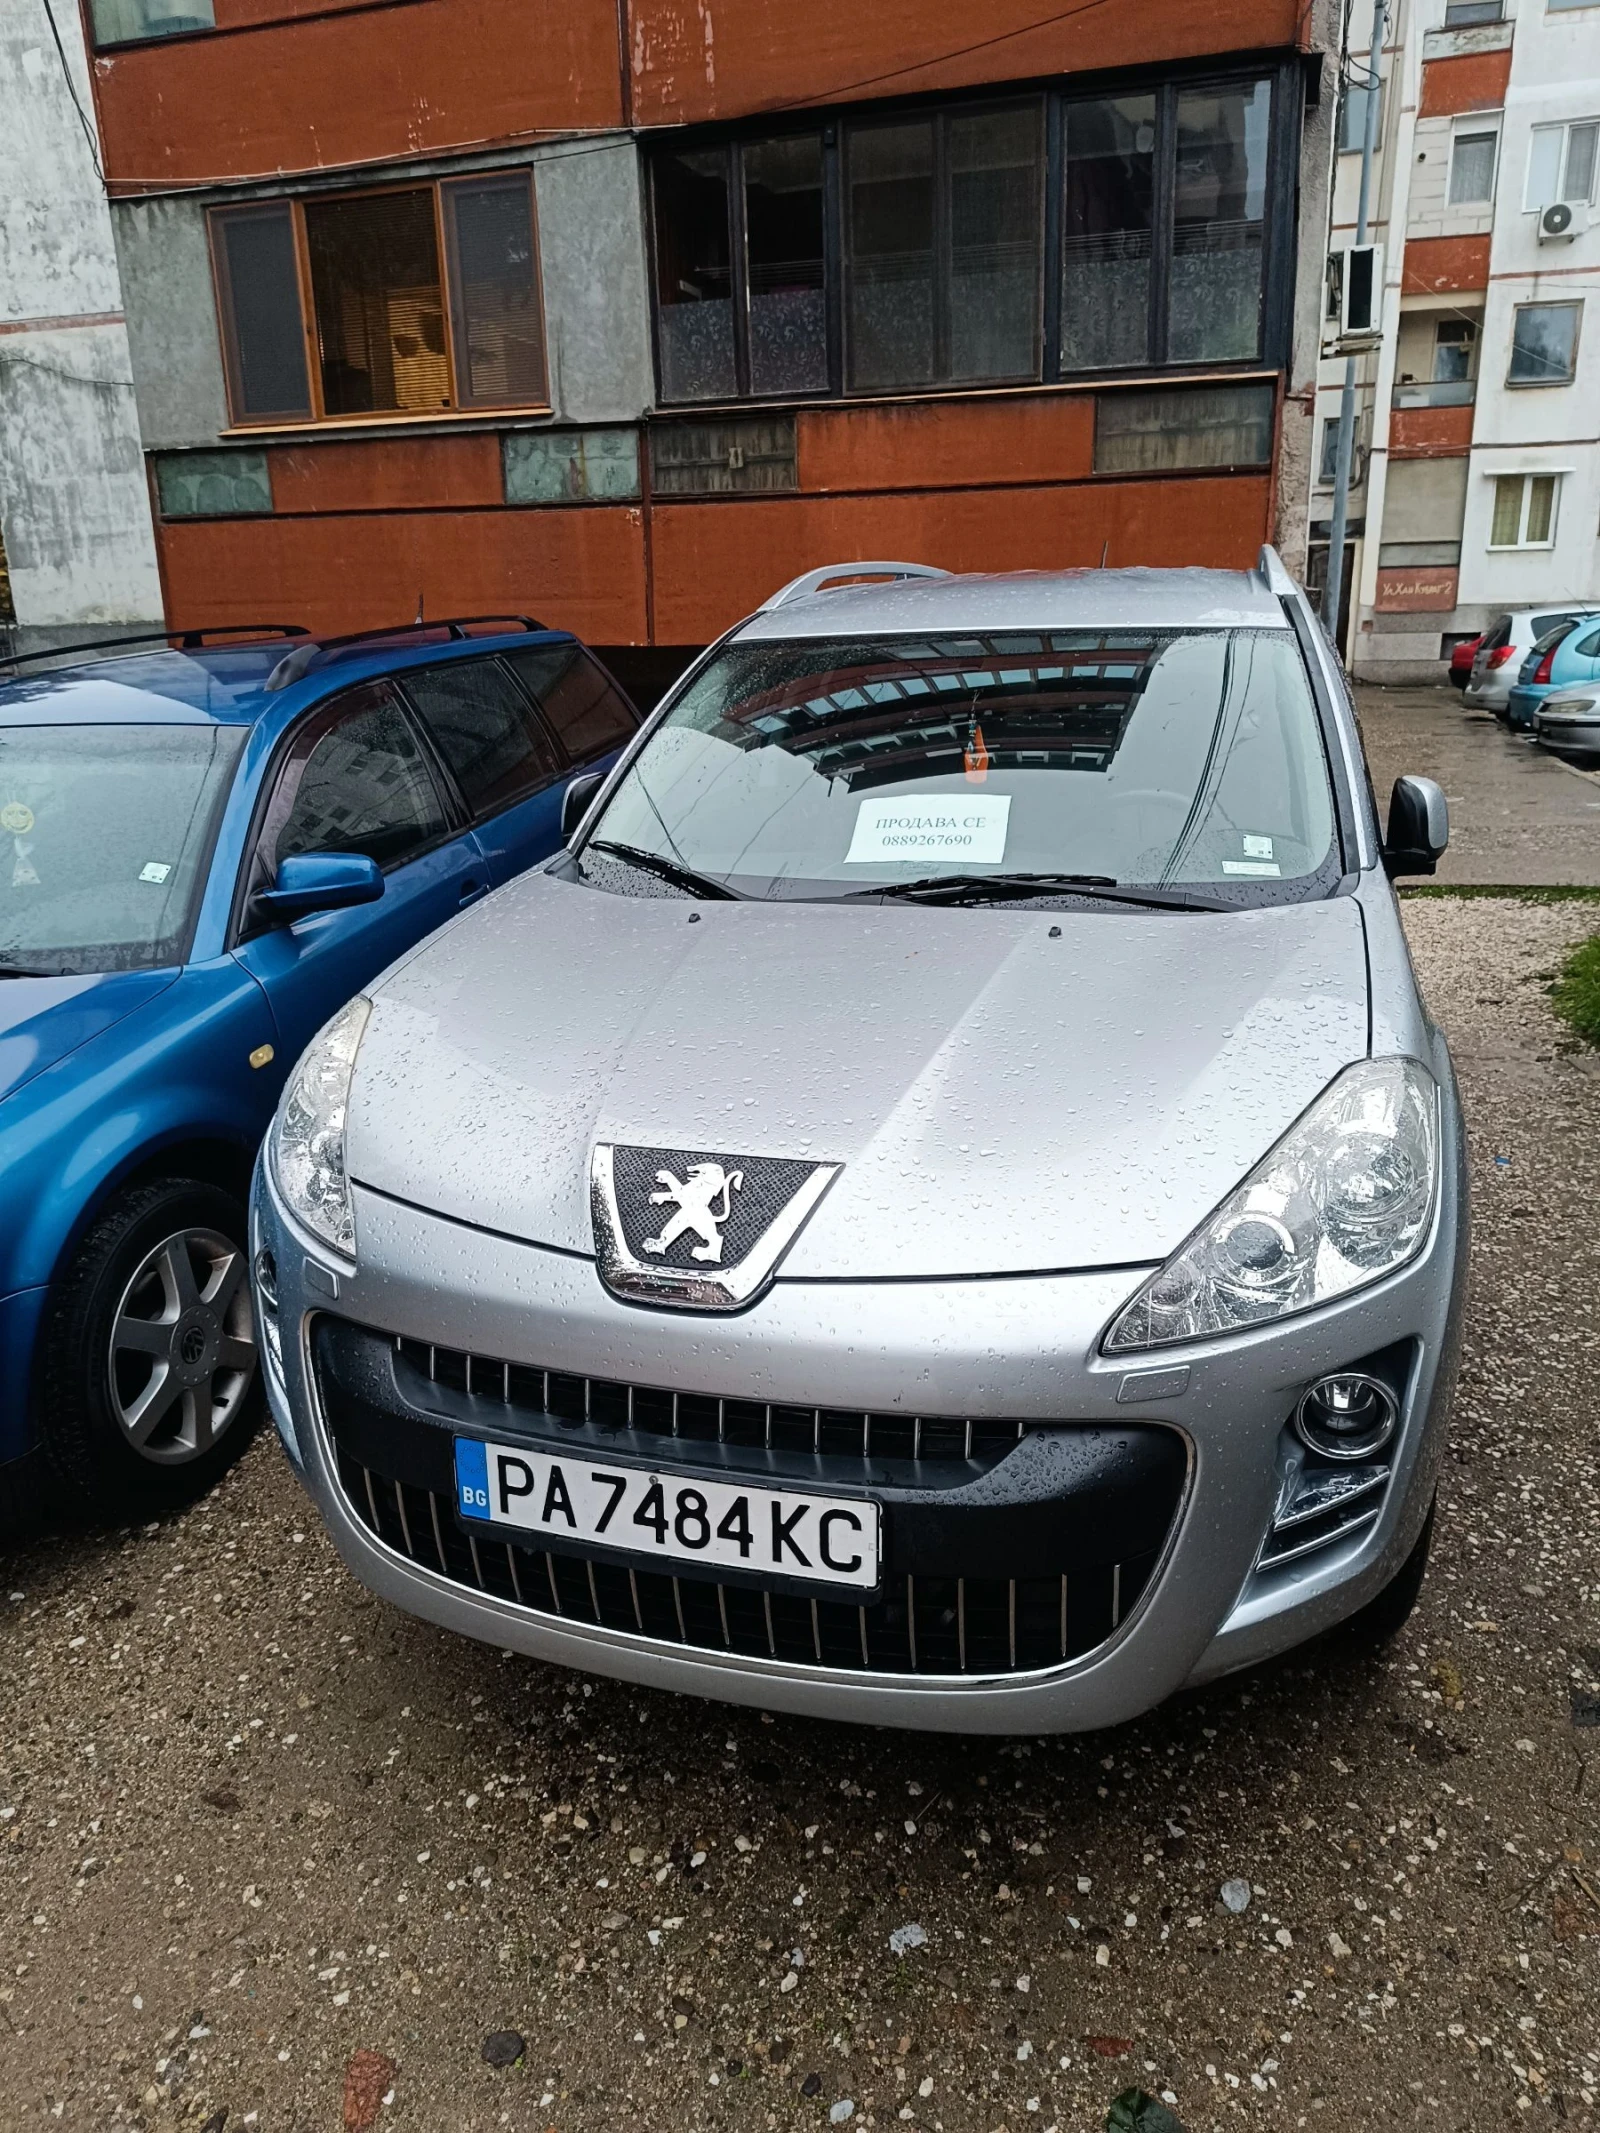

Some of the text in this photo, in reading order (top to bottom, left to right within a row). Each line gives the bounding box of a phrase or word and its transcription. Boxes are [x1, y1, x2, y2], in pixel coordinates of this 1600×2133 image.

[1444, 581, 1453, 595] 2
[875, 816, 986, 830] ПРОДАВА СЕ
[882, 835, 972, 846] 0889267690
[463, 1486, 487, 1507] BG
